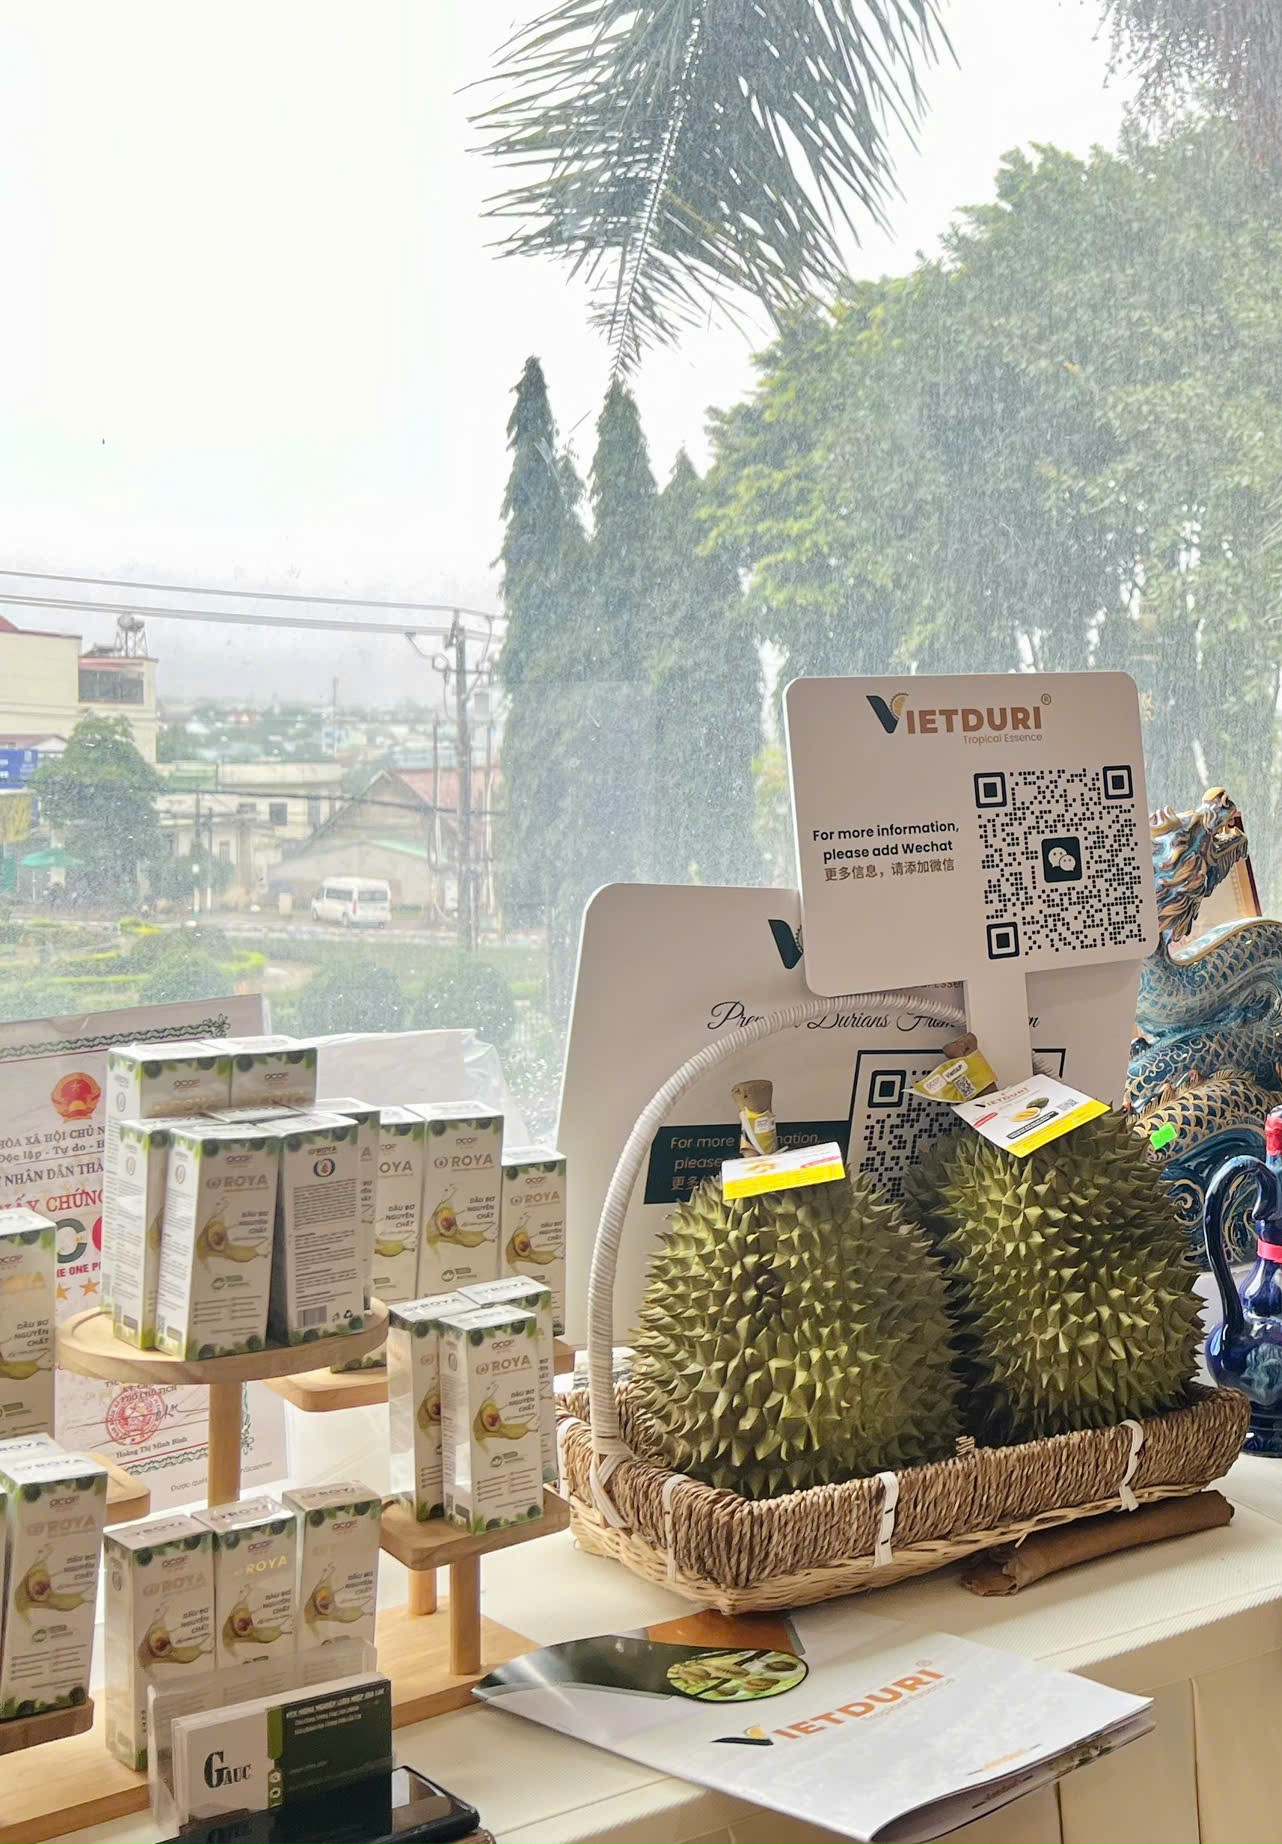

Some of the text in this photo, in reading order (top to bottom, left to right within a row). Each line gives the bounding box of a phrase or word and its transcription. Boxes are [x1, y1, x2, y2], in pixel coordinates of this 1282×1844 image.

[866, 692, 1043, 735] VIETDURI
[963, 732, 1043, 746] Tropical Essence
[812, 820, 959, 841] For more information,
[823, 840, 953, 864] please add Wechat
[69, 1124, 94, 1140] CHỦ
[670, 1136, 693, 1149] For
[696, 1135, 735, 1148] more
[5, 1168, 44, 1187] NHÂN
[47, 1164, 75, 1181] DÂN
[379, 1160, 413, 1174] OYA
[69, 1264, 89, 1276] ONE
[709, 1668, 945, 1747] VIETDURI
